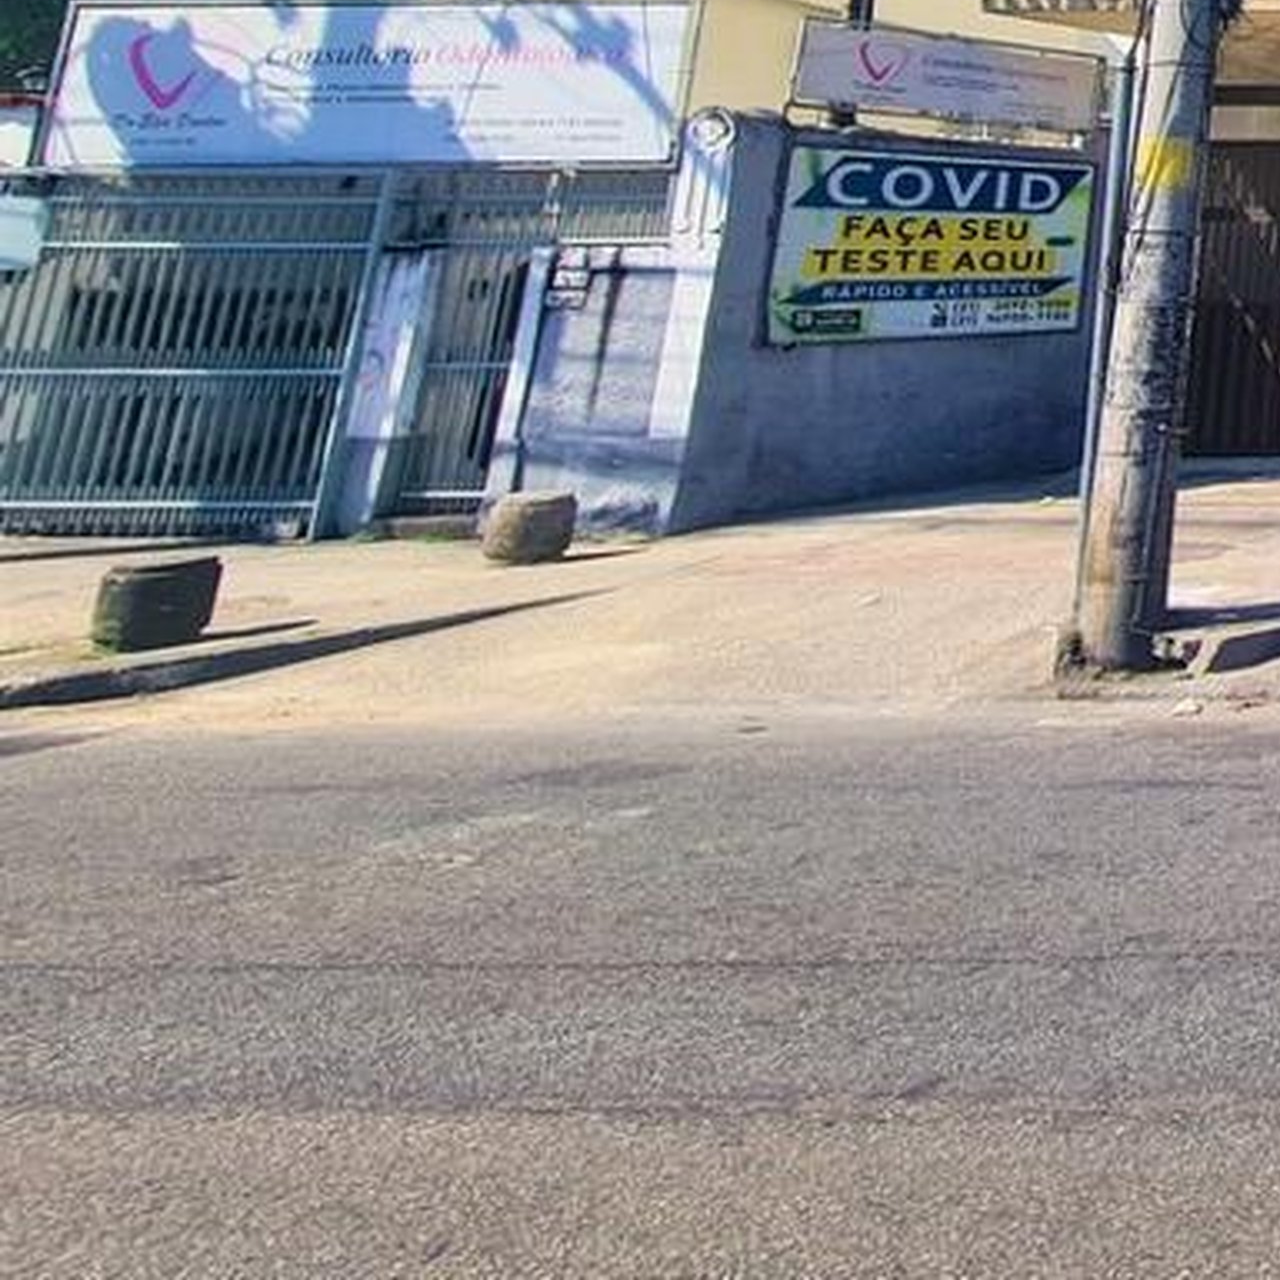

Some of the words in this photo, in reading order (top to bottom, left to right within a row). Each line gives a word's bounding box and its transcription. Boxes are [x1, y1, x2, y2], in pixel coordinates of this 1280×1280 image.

[826, 162, 1062, 212] COVID
[843, 216, 945, 247] FAÇA
[959, 218, 1030, 241] SEU
[812, 249, 939, 274] TESTE
[952, 248, 1046, 273] AQUI
[822, 282, 906, 300] RÁPIDO
[937, 277, 1043, 299] ACESSÍVEL
